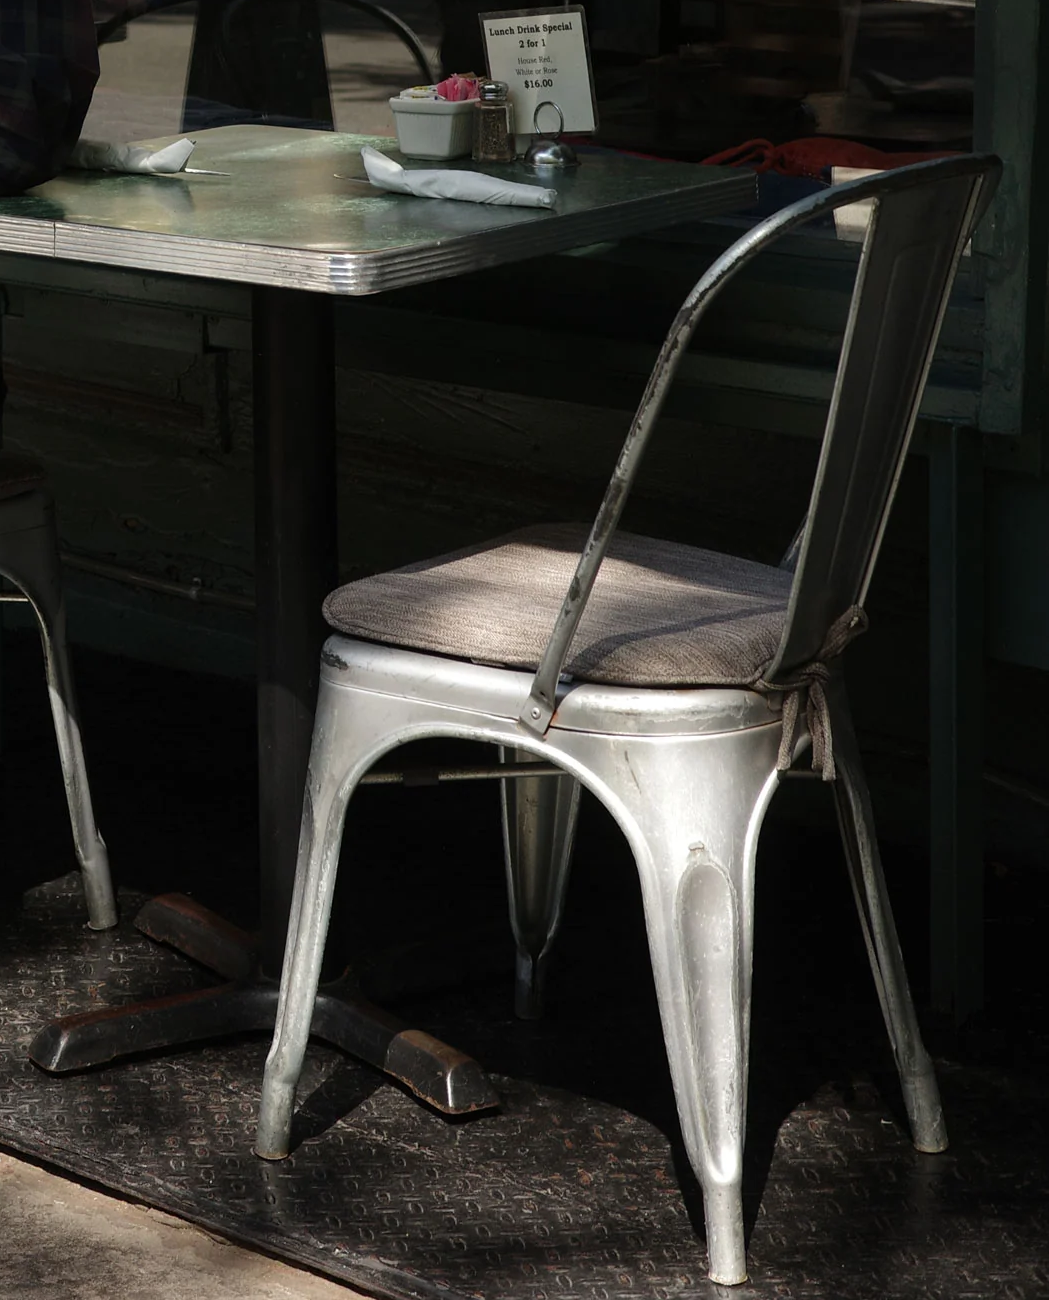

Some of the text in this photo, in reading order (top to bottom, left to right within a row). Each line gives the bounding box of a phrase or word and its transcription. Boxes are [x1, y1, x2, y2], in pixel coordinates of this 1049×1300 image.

[489, 22, 572, 36] Lunch Drink Special
[518, 39, 546, 48] 2 for 1
[517, 57, 537, 65] House
[515, 68, 534, 76] White
[542, 67, 558, 75] Rose
[524, 79, 553, 89] $16.00
